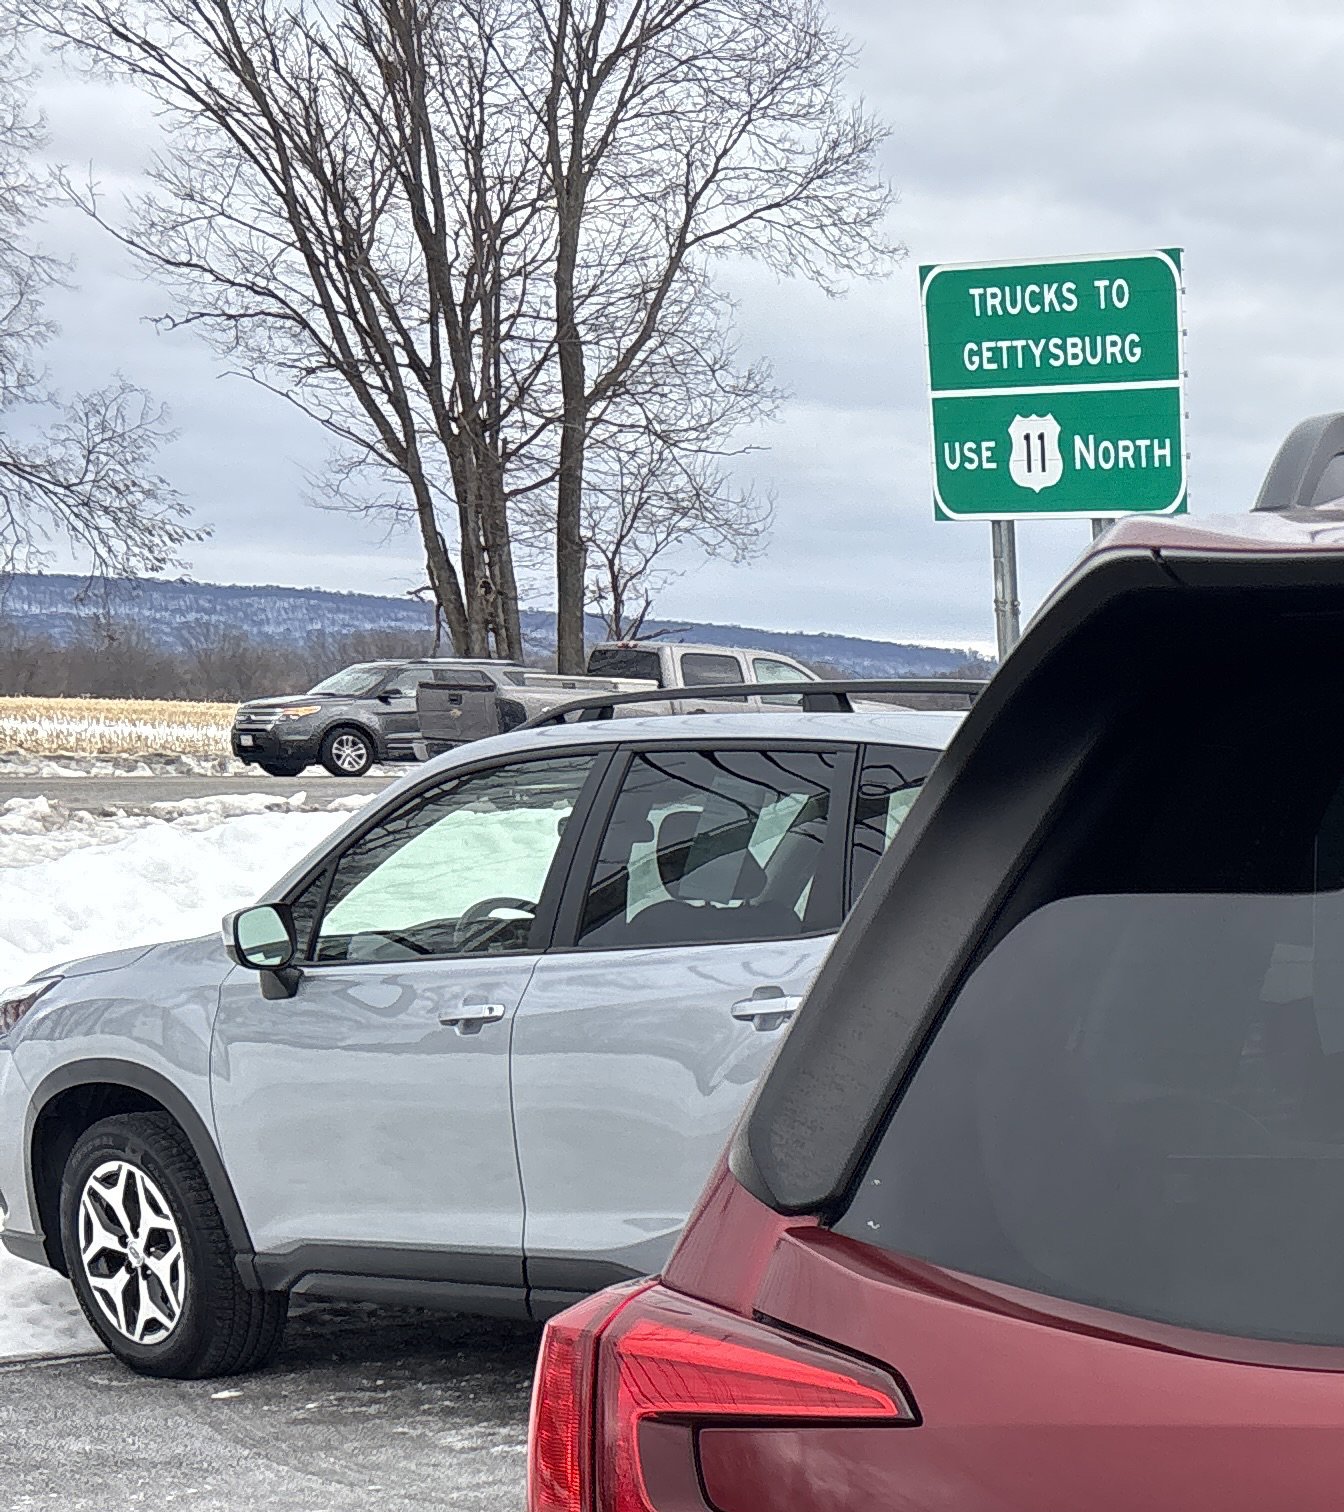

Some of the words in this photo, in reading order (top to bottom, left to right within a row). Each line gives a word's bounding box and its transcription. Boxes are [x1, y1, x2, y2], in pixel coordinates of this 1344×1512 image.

[968, 281, 1078, 317] TRUCKS
[1094, 278, 1129, 310] TO
[963, 333, 1142, 371] GETTYSBURG
[943, 440, 998, 471] USE
[1023, 431, 1047, 474] 11
[1073, 434, 1172, 470] NORTH
